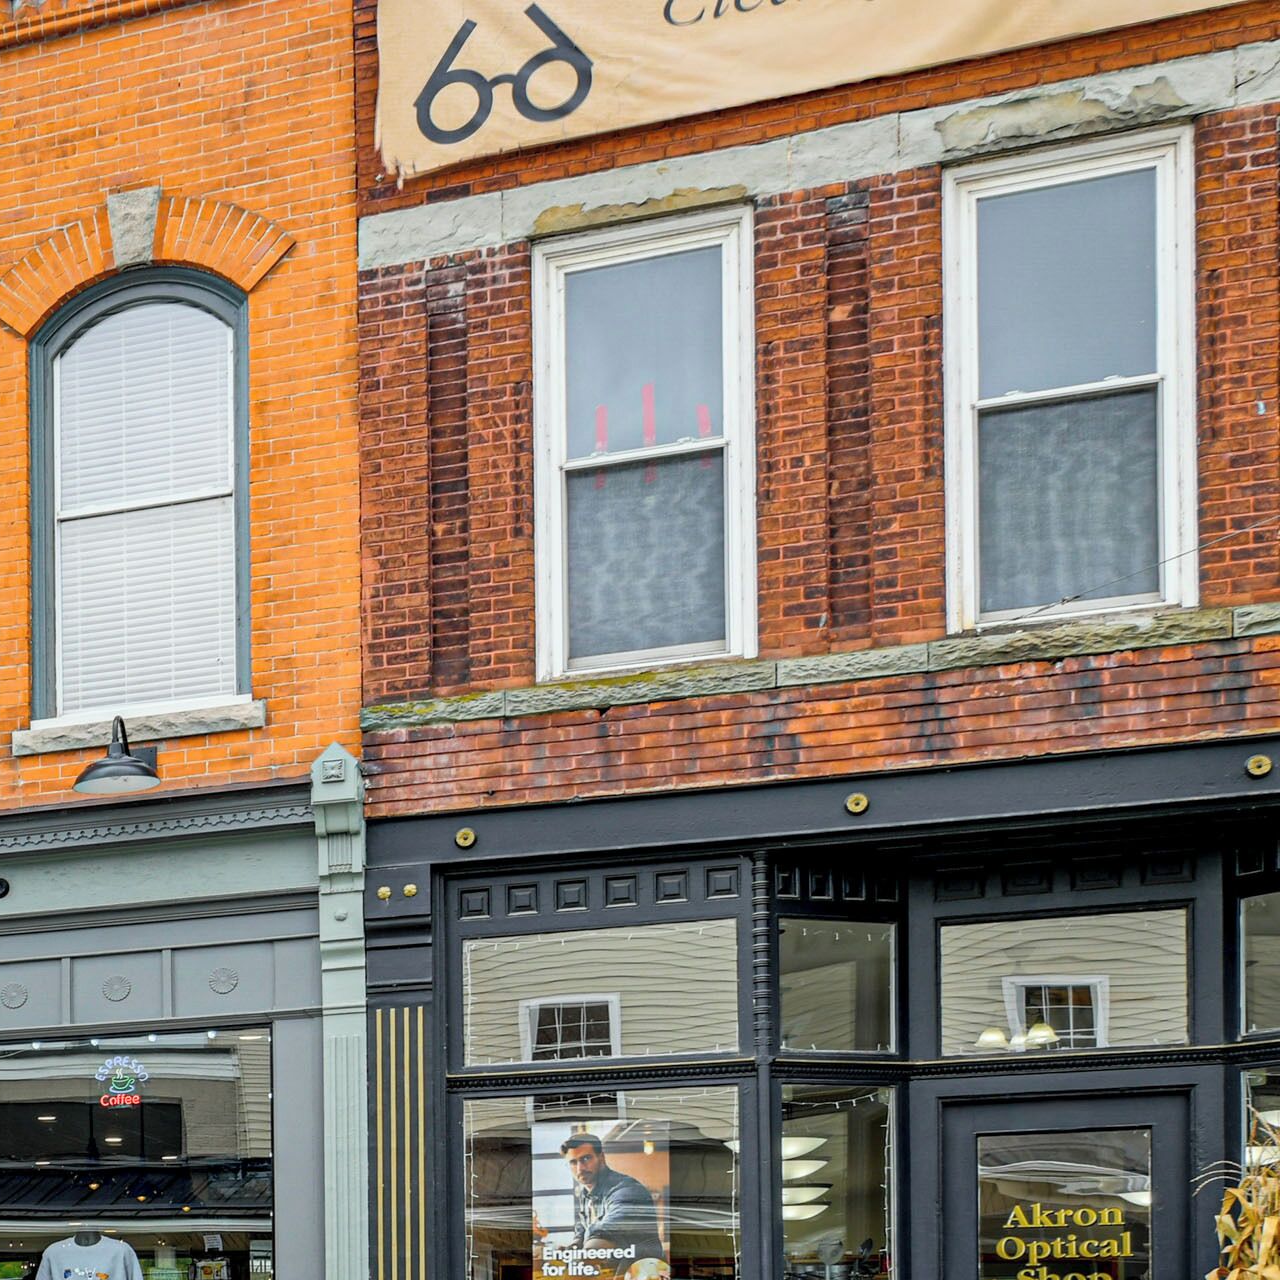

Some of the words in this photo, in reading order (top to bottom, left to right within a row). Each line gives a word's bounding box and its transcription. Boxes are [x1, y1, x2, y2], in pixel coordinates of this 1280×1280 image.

[95, 1056, 149, 1082] ESPRESSO
[100, 1094, 141, 1107] Coffee
[1002, 1203, 1126, 1228] Akron
[542, 1245, 636, 1262] Engineered
[996, 1231, 1135, 1266] Optical
[542, 1263, 566, 1276] for
[568, 1262, 600, 1276] life.
